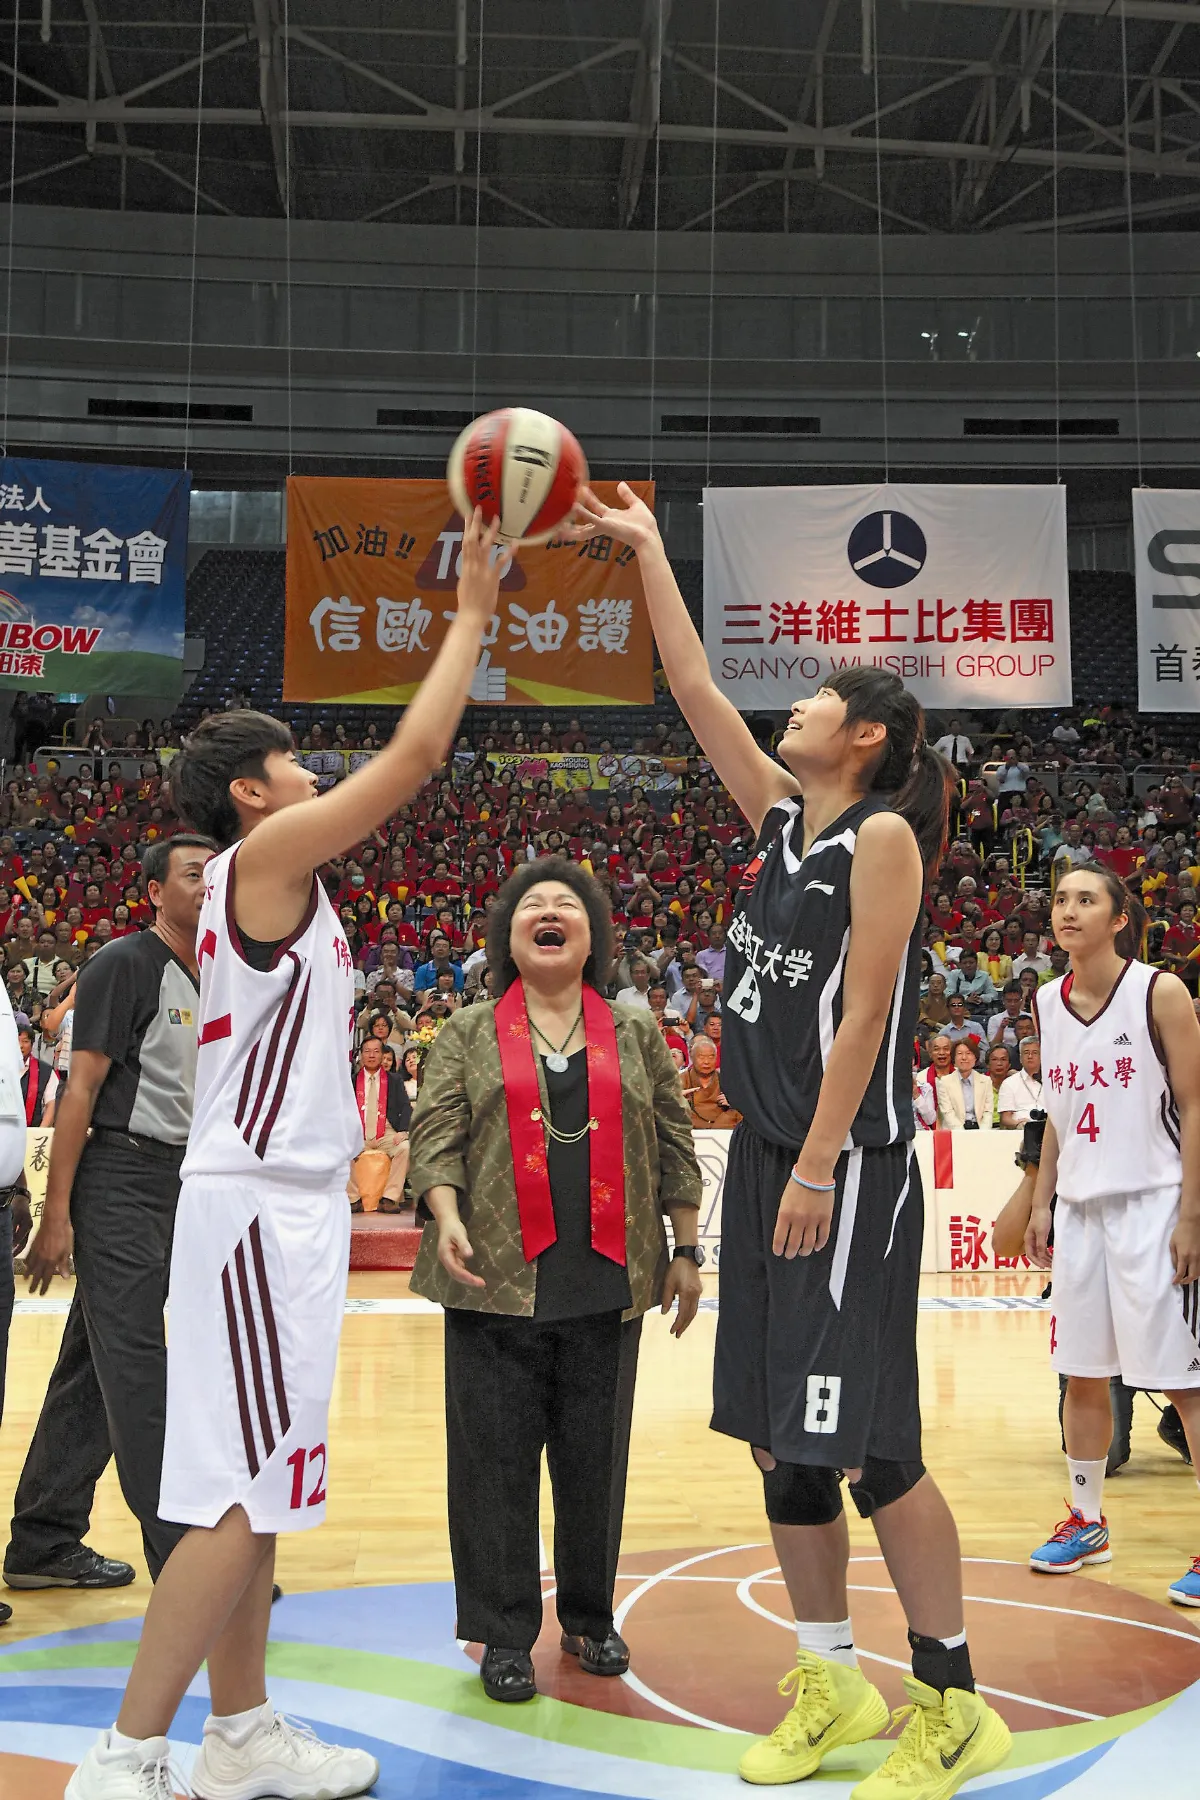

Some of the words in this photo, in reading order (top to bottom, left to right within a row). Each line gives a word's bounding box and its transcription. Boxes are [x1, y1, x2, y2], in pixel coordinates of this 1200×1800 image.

[0, 521, 168, 585] 善基金會
[721, 598, 1055, 645] 三洋維士比集團
[721, 656, 820, 680] SANYO
[956, 654, 1055, 678] GROUP
[1150, 643, 1200, 683] 首
[1048, 1056, 1137, 1094] 佛光大學
[1076, 1102, 1100, 1143] 4
[803, 1374, 842, 1434] 8
[286, 1442, 326, 1510] 12
